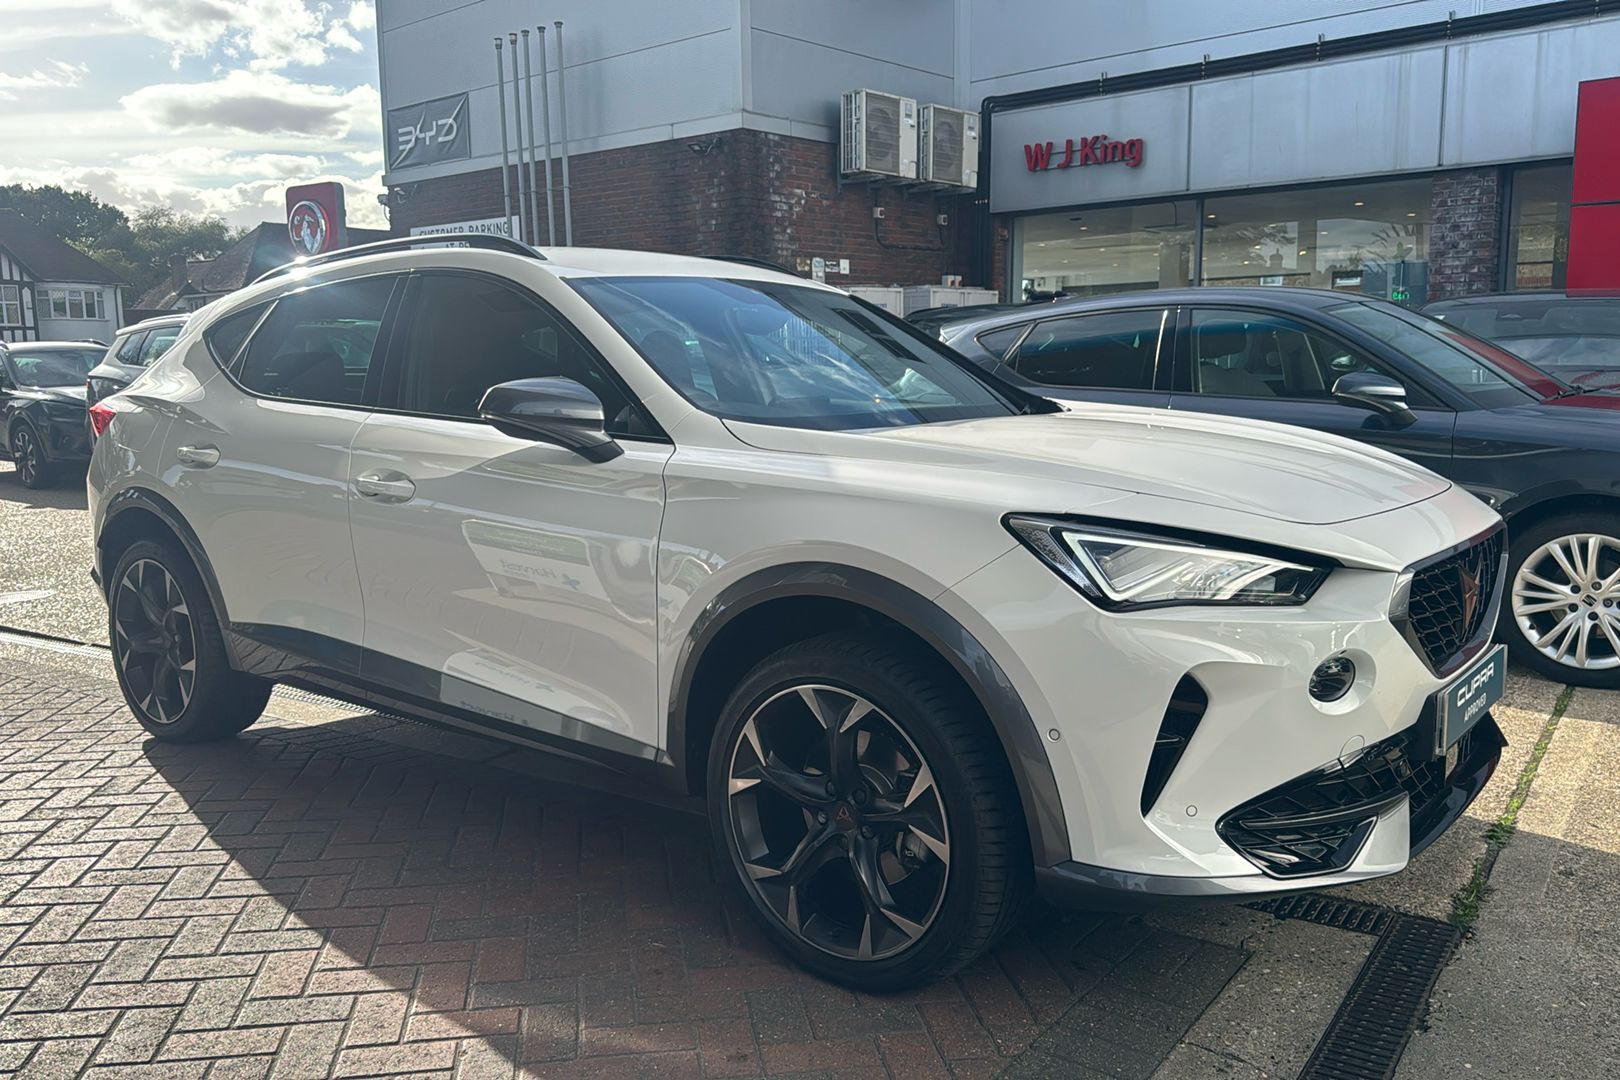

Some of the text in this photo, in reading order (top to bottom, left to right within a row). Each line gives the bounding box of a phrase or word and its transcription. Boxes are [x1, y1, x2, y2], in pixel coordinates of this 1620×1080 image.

[398, 117, 457, 151] BYD
[1024, 134, 1143, 172] W J King
[468, 222, 508, 234] PARKING
[1457, 662, 1494, 707] CUPRA
[1464, 693, 1487, 722] APPROVED
